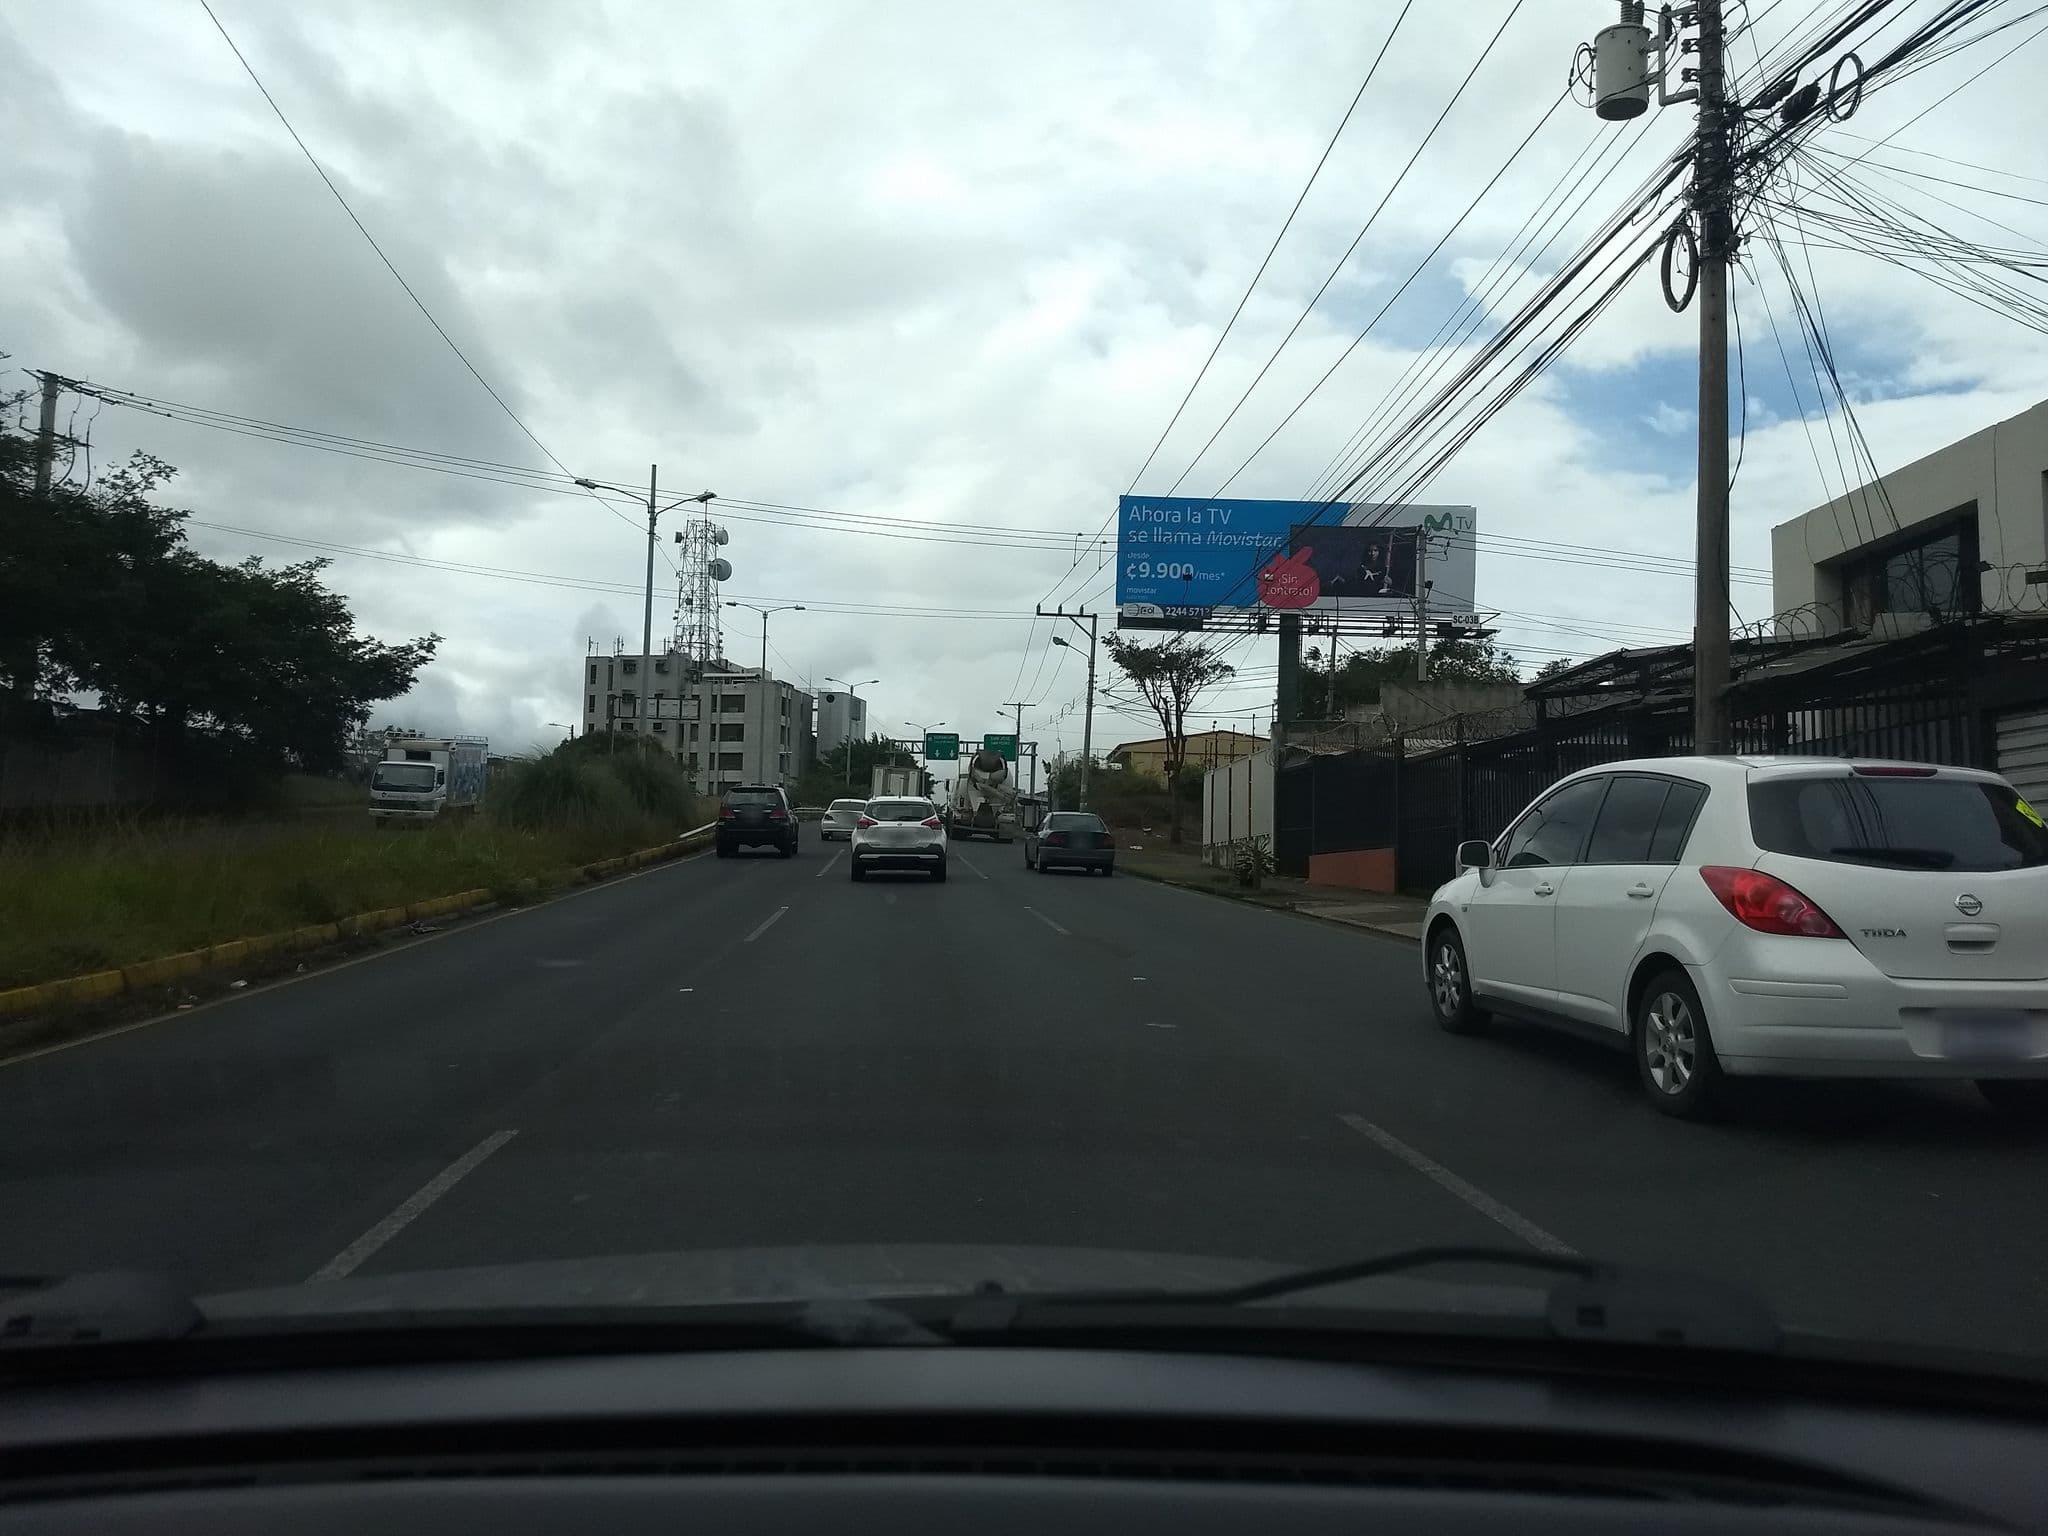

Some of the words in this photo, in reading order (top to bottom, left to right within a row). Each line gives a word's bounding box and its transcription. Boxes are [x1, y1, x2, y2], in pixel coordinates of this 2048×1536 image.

[1128, 505, 1182, 523] Ahora
[1186, 507, 1202, 524] la
[1206, 508, 1233, 525] TV
[1128, 530, 1149, 543] se
[1153, 527, 1202, 545] llama
[1266, 586, 1313, 597] ontrato!
[1165, 606, 1187, 617] 2244
[1859, 928, 1908, 939] TIIDA
